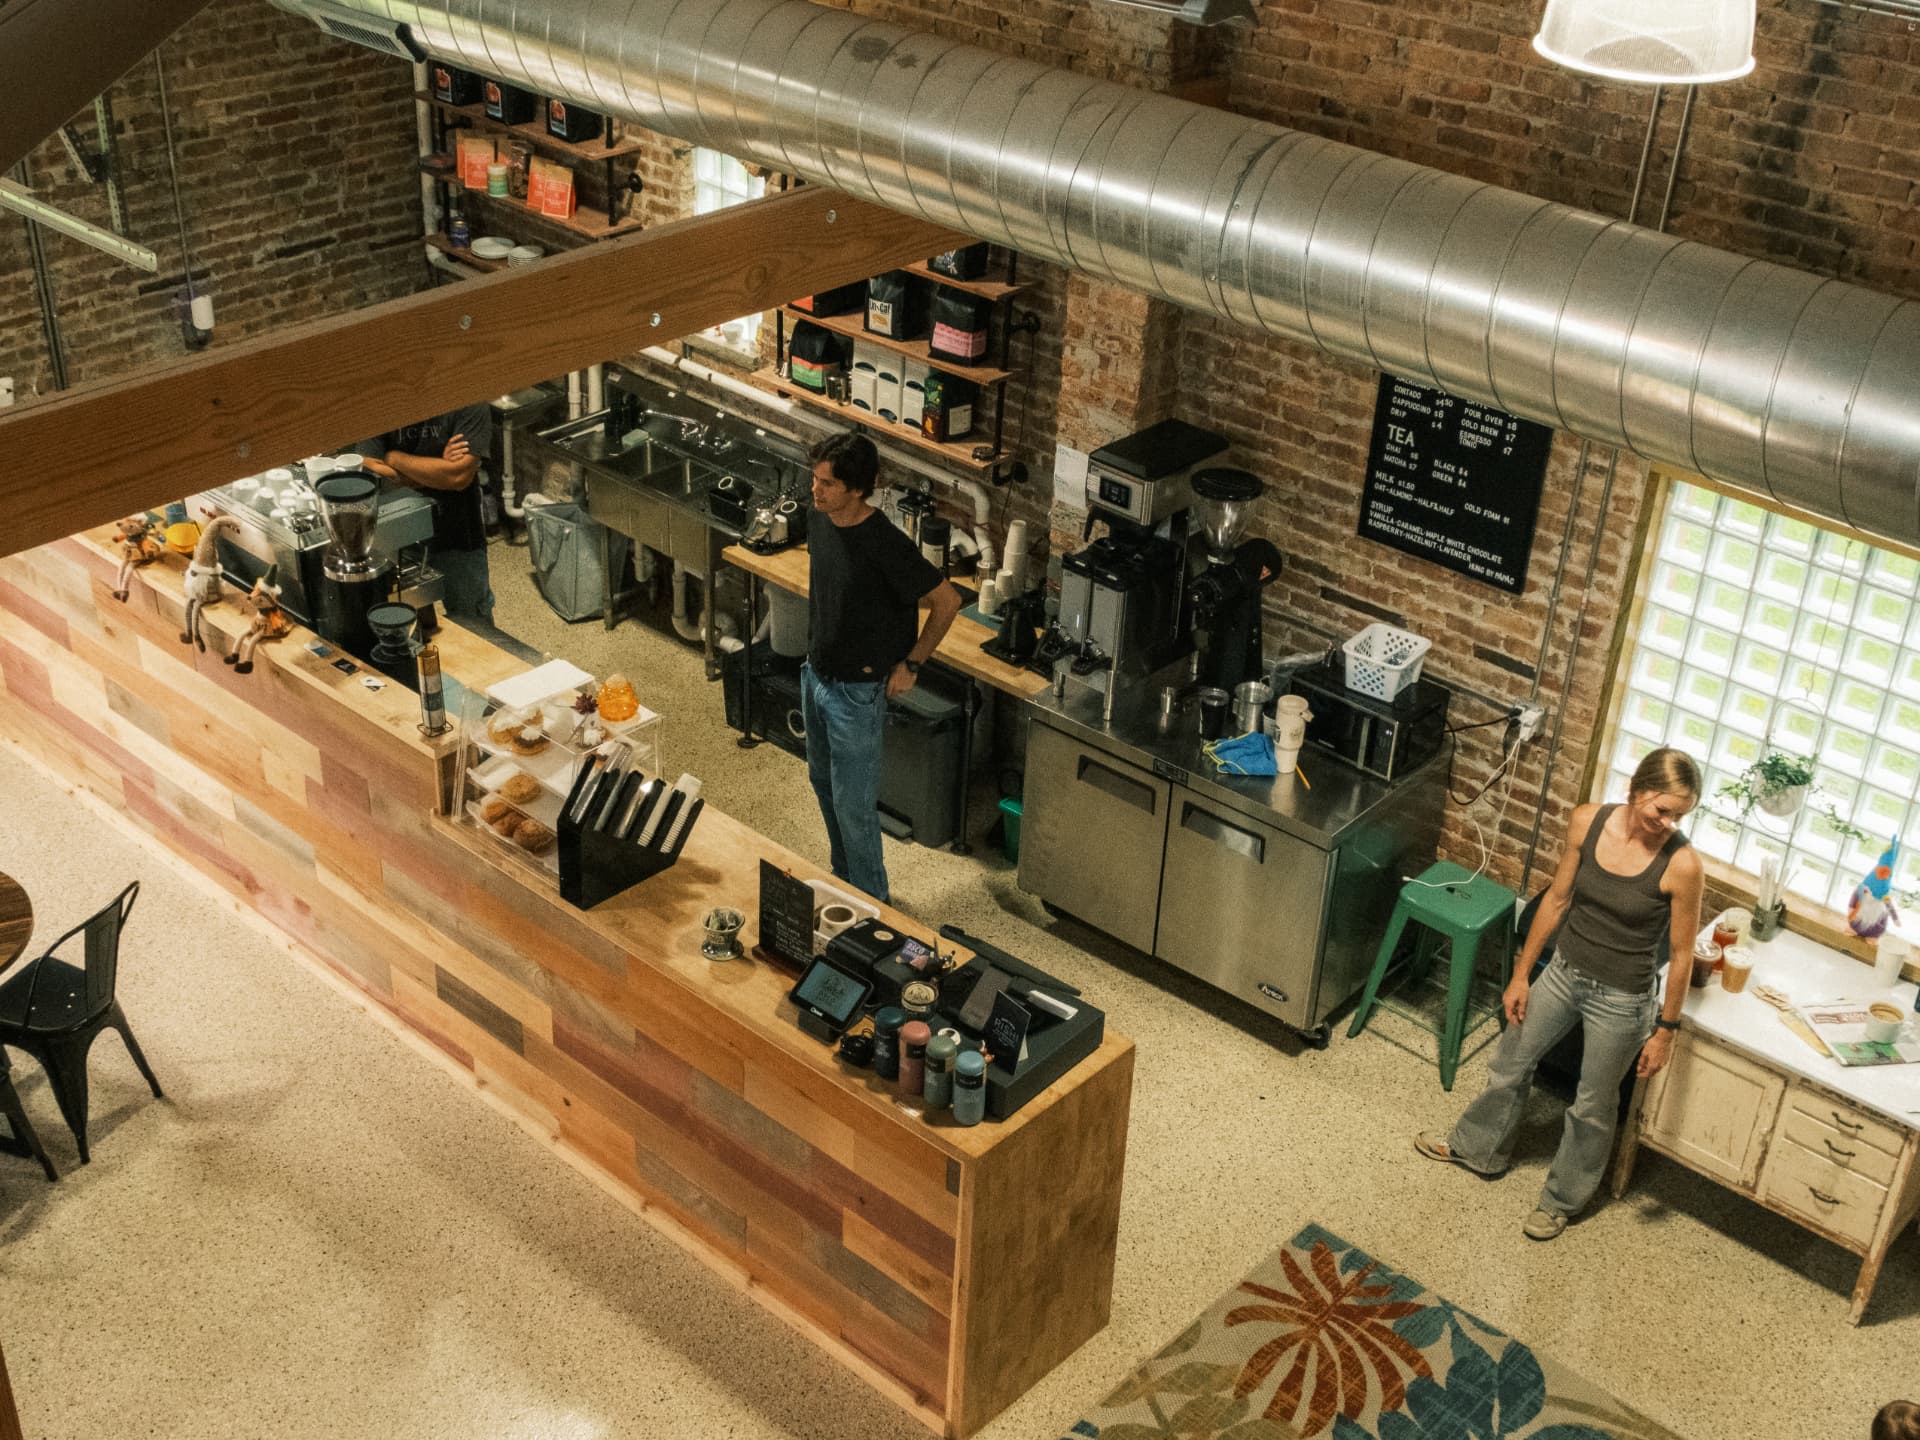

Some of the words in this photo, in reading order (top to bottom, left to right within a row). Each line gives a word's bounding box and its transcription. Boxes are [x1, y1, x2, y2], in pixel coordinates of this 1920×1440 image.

[1394, 384, 1421, 399] CORTADO
[1390, 407, 1407, 418] DRIP
[1392, 396, 1431, 415] CAPPUCCINO
[1464, 407, 1482, 419] POUR
[1485, 414, 1503, 427] OVER
[1461, 418, 1478, 430] COLD
[1480, 424, 1499, 437] BREW
[1387, 423, 1415, 448] TEA
[1459, 430, 1492, 446] ESPRESSO
[1385, 442, 1401, 454] CHAI
[1383, 453, 1407, 468] MATCHA
[1434, 459, 1456, 473] BLACK
[1375, 470, 1395, 484] MILK
[1432, 470, 1453, 484] GREEN
[1370, 500, 1394, 514] SYRUP
[1464, 502, 1481, 514] COLD
[1483, 509, 1500, 521] FOAM
[1467, 545, 1502, 564] CHOCOLATE
